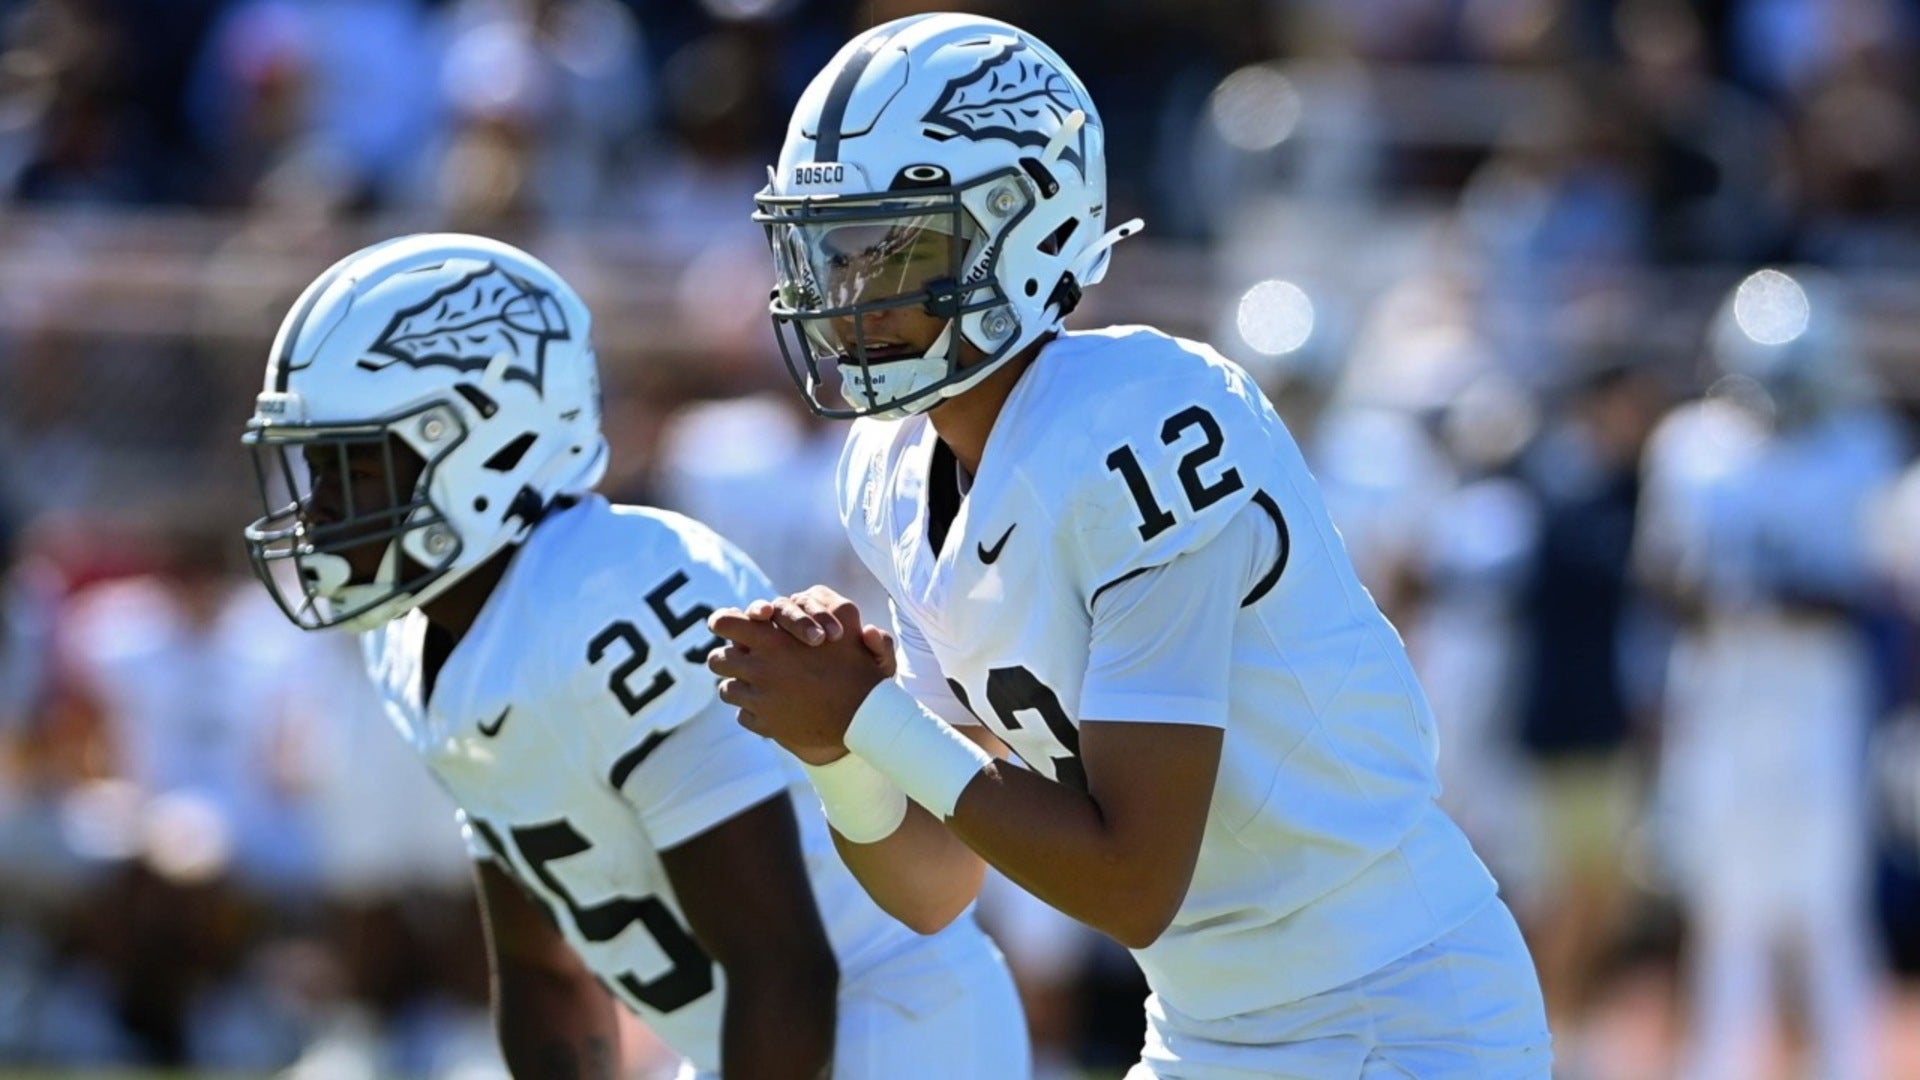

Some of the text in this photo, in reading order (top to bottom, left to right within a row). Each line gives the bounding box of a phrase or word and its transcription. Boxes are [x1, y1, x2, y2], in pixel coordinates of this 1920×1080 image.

[795, 166, 844, 185] BOSCO
[1106, 405, 1245, 542] 12
[586, 568, 727, 716] 25
[946, 665, 1089, 796] 2
[469, 815, 715, 1015] 5
